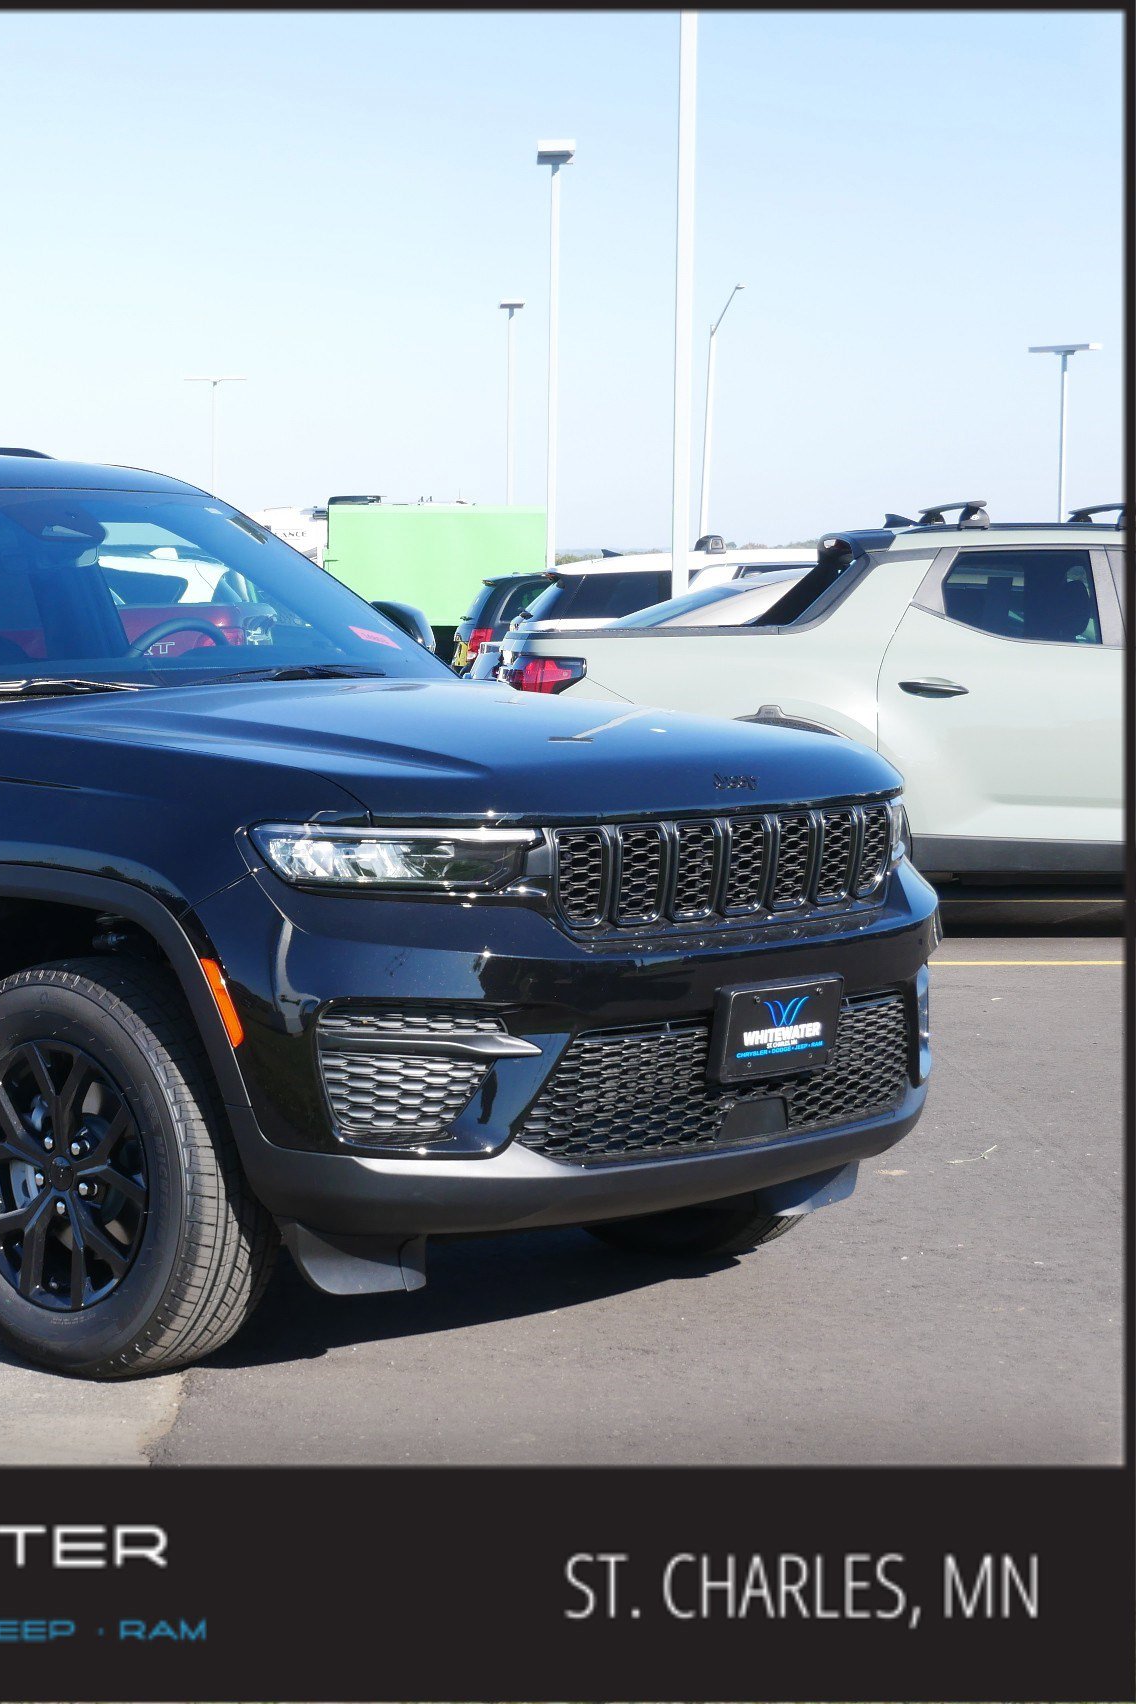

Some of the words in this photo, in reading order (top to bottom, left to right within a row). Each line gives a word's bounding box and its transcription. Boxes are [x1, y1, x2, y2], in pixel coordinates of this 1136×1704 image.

[743, 1022, 821, 1046] WHITEWATER
[736, 1049, 768, 1059] CHRYSLER
[771, 1046, 791, 1054] DODGE
